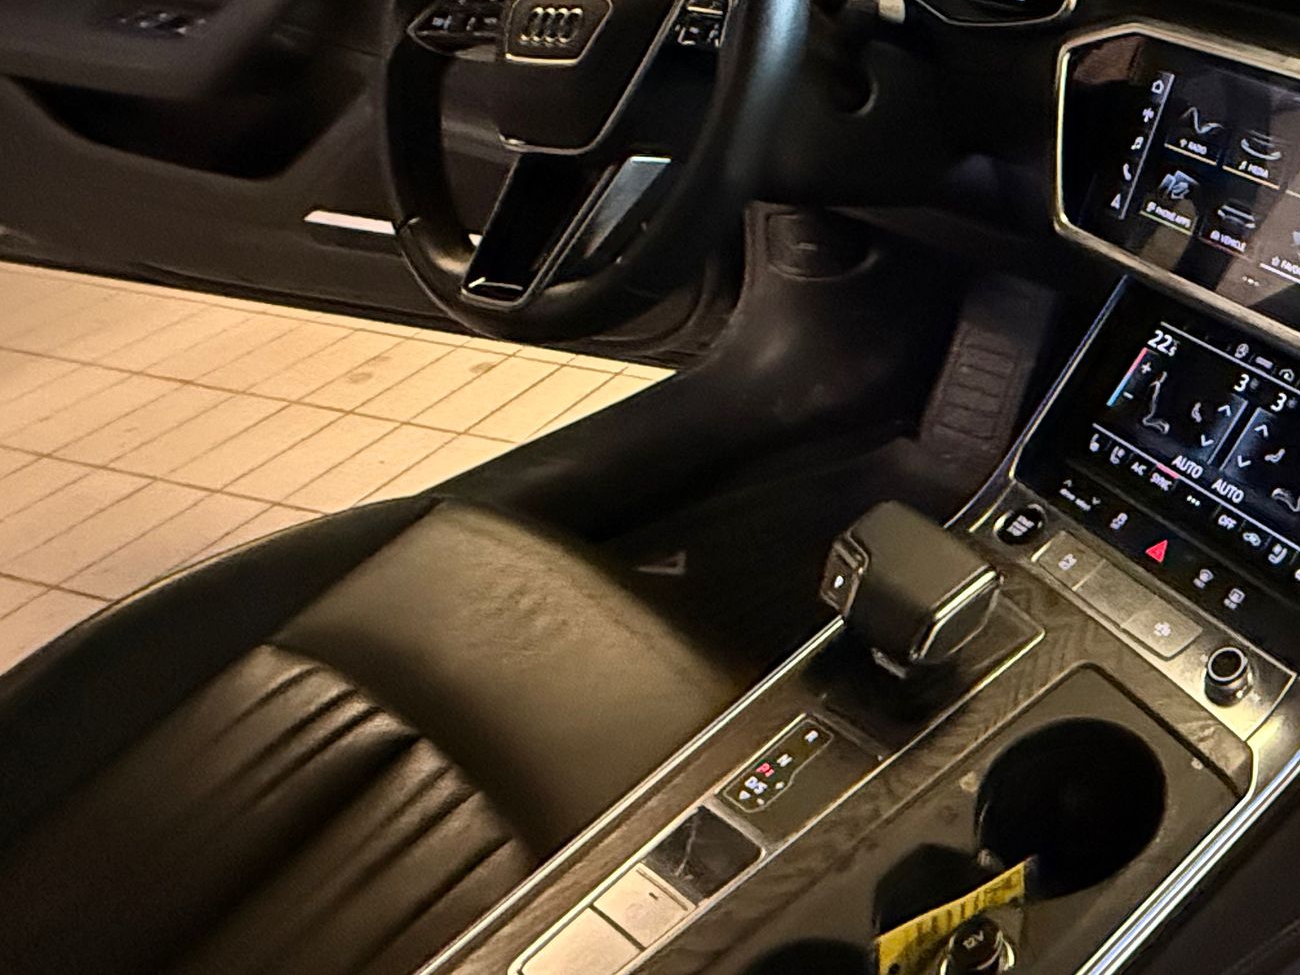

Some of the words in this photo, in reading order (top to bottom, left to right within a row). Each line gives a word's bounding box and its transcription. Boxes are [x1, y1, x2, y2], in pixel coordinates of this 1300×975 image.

[1233, 373, 1250, 392] 3
[1270, 392, 1287, 412] 3
[1171, 455, 1204, 479] AUTO
[1211, 478, 1245, 504] AUTO
[1217, 514, 1238, 530] OFF
